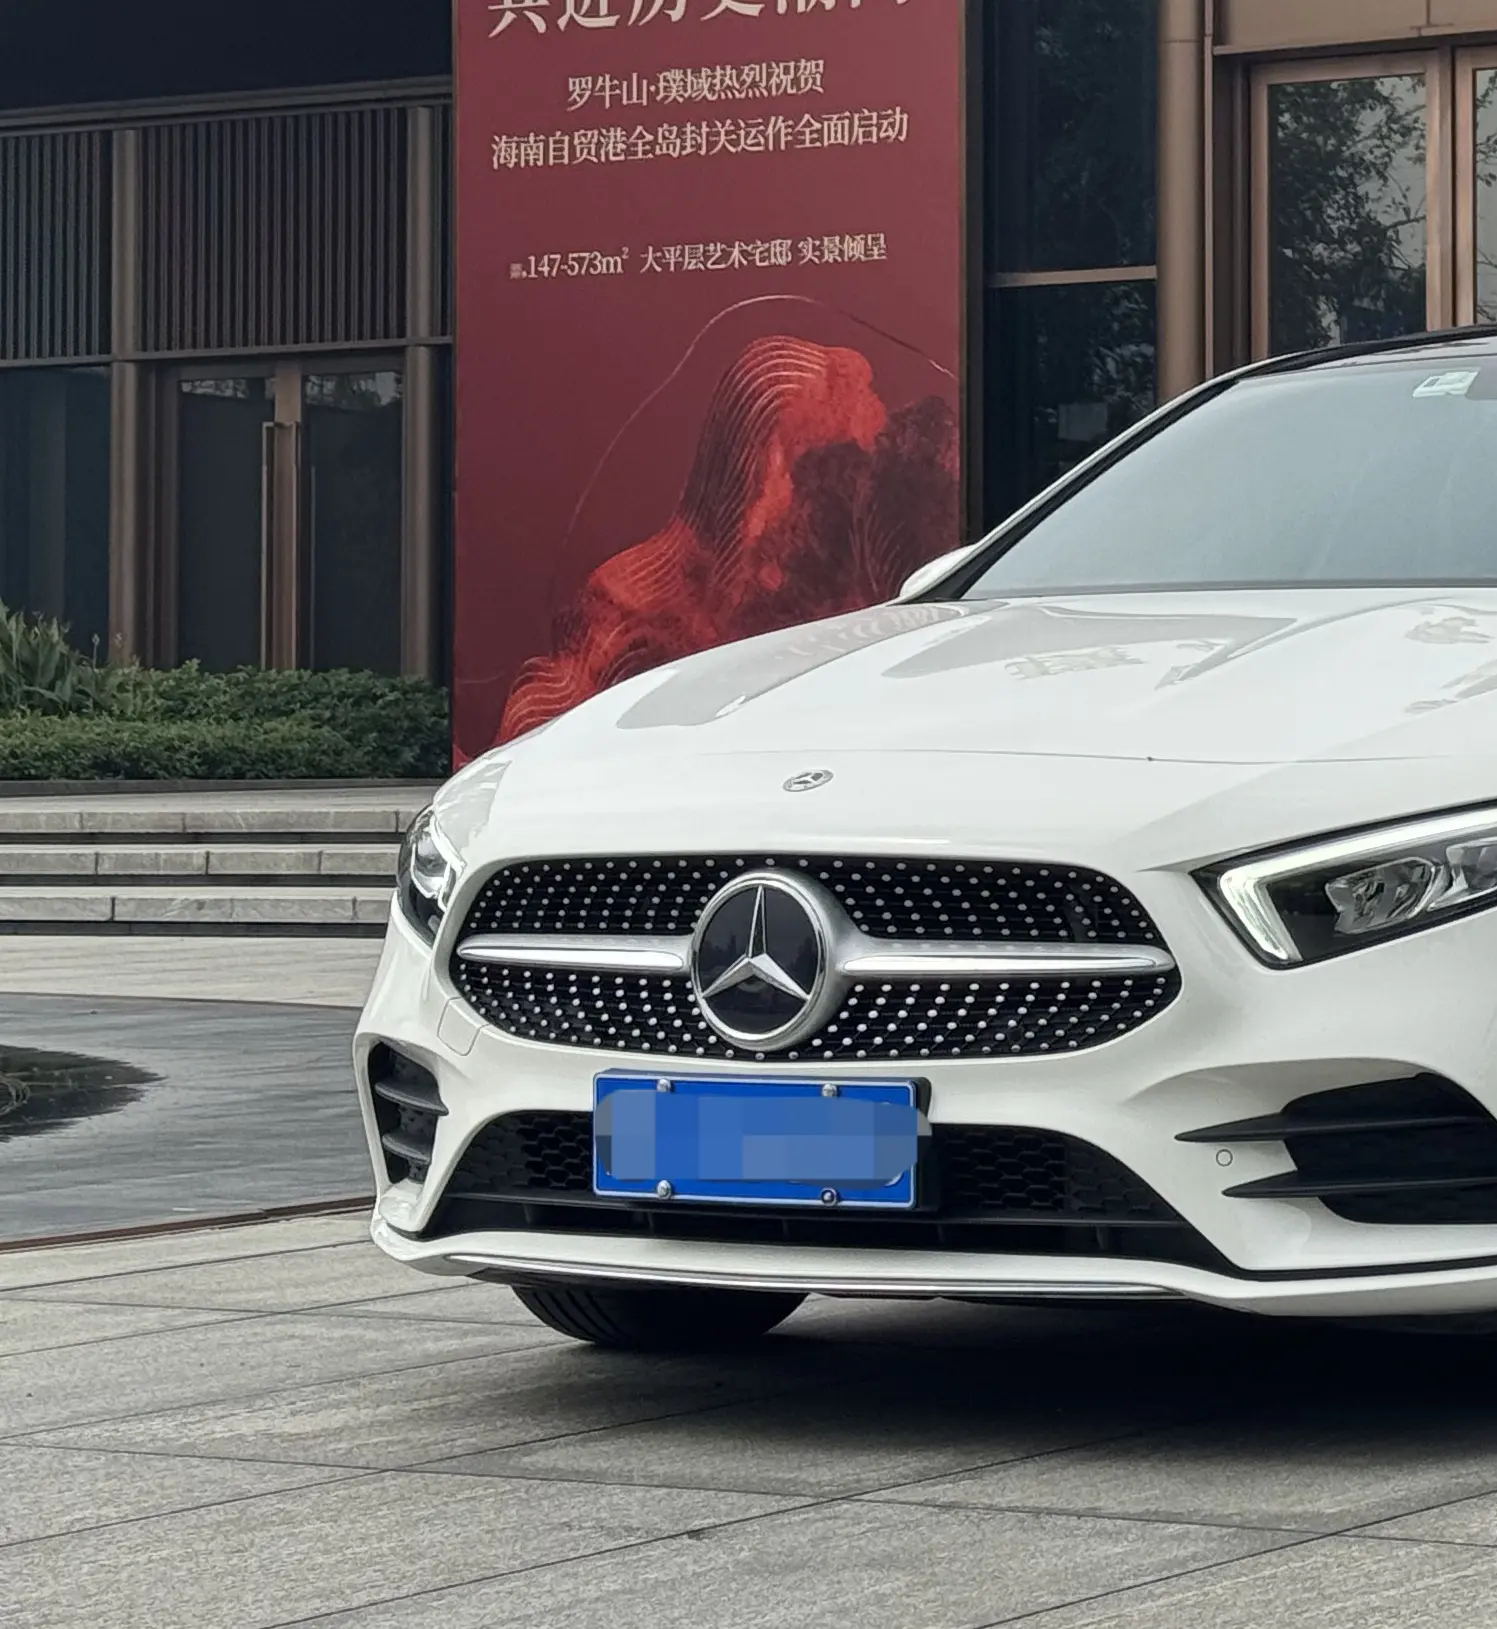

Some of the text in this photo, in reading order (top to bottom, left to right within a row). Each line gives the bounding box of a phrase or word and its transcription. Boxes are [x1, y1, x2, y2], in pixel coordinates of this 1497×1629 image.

[492, 107, 908, 169] 海南自贸港全岛封关运作全面启动
[641, 239, 792, 272] 大平层艺术宅邸
[798, 233, 886, 264] 实景倾呈
